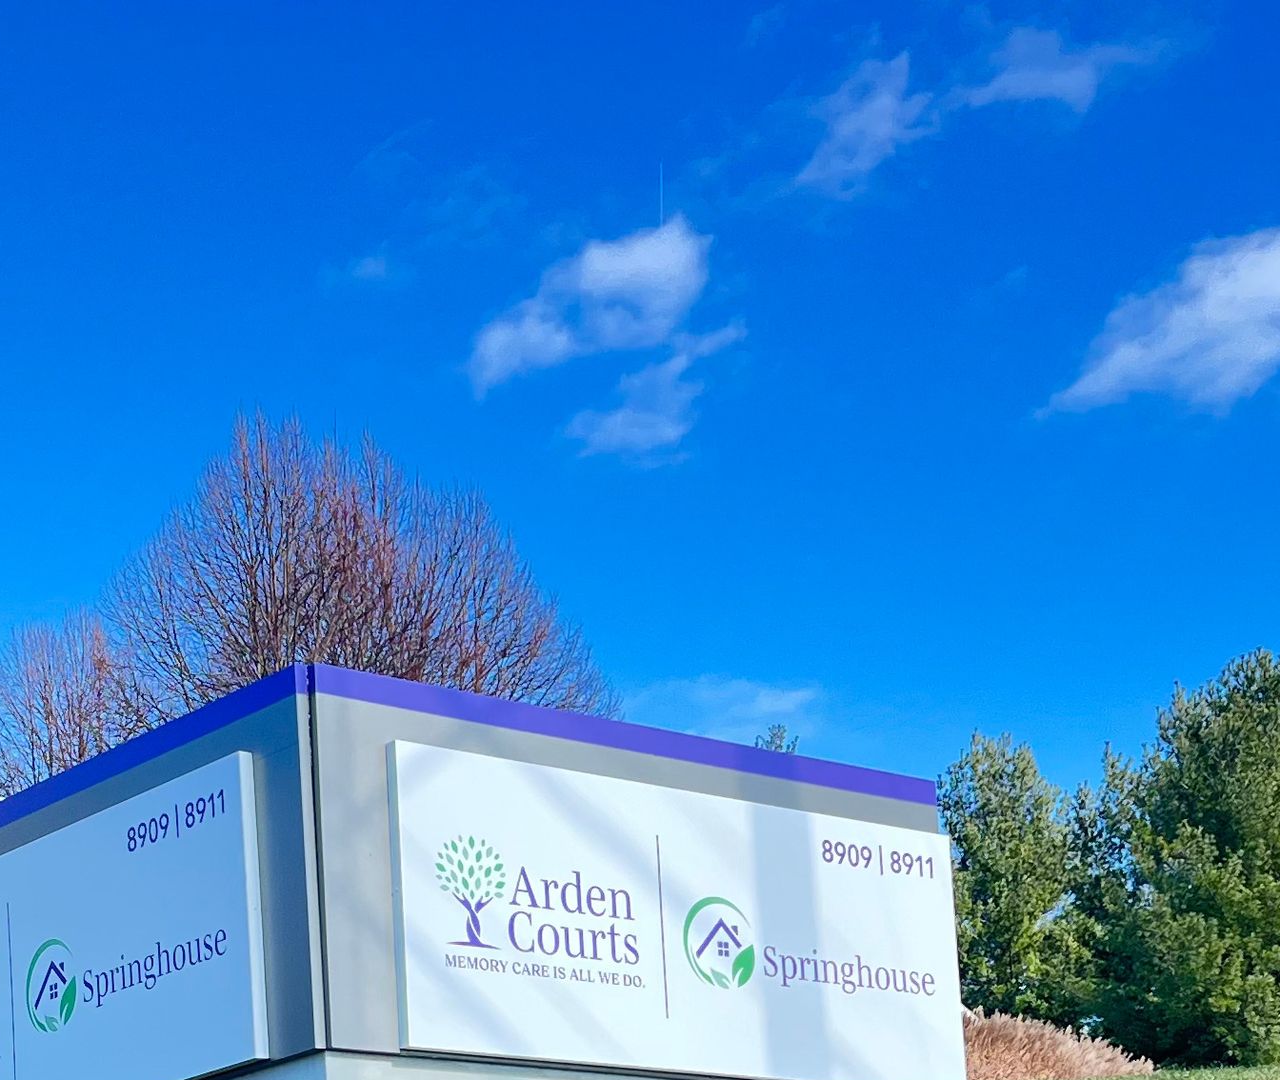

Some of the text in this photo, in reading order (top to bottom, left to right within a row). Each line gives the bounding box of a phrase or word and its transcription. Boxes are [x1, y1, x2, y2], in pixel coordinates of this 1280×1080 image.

[127, 789, 226, 852] 8909 8911
[822, 839, 934, 879] 8909 8911
[510, 866, 635, 921] Arden
[507, 911, 640, 965] Courts
[83, 928, 227, 1007] Springhouse
[445, 953, 646, 989] MEMORY CARE IS ALL WE DO.
[763, 945, 936, 996] Springhouse
